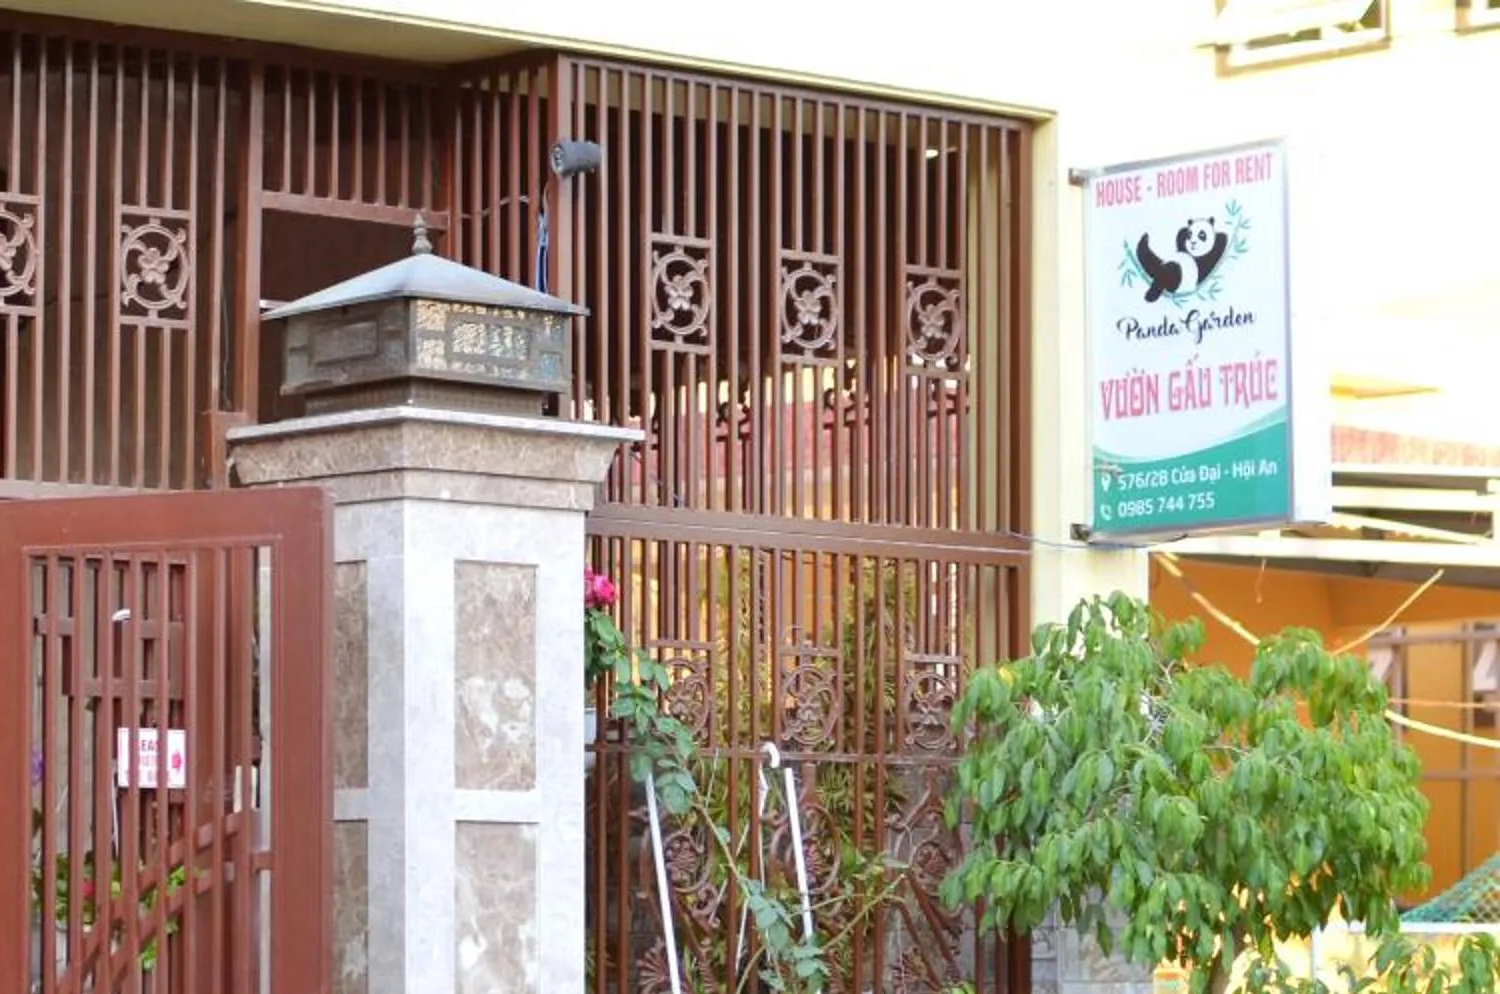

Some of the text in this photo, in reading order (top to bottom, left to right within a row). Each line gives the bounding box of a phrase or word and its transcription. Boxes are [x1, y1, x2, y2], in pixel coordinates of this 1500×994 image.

[1095, 176, 1142, 208] HOUSE
[1157, 165, 1199, 199] ROOM
[1203, 160, 1231, 190] FOR
[1235, 152, 1273, 185] RENT
[1116, 306, 1255, 345] Panda Garden
[1219, 350, 1278, 408] TRÚC
[1258, 458, 1278, 476] An
[1117, 491, 1216, 518] 0985 744 755
